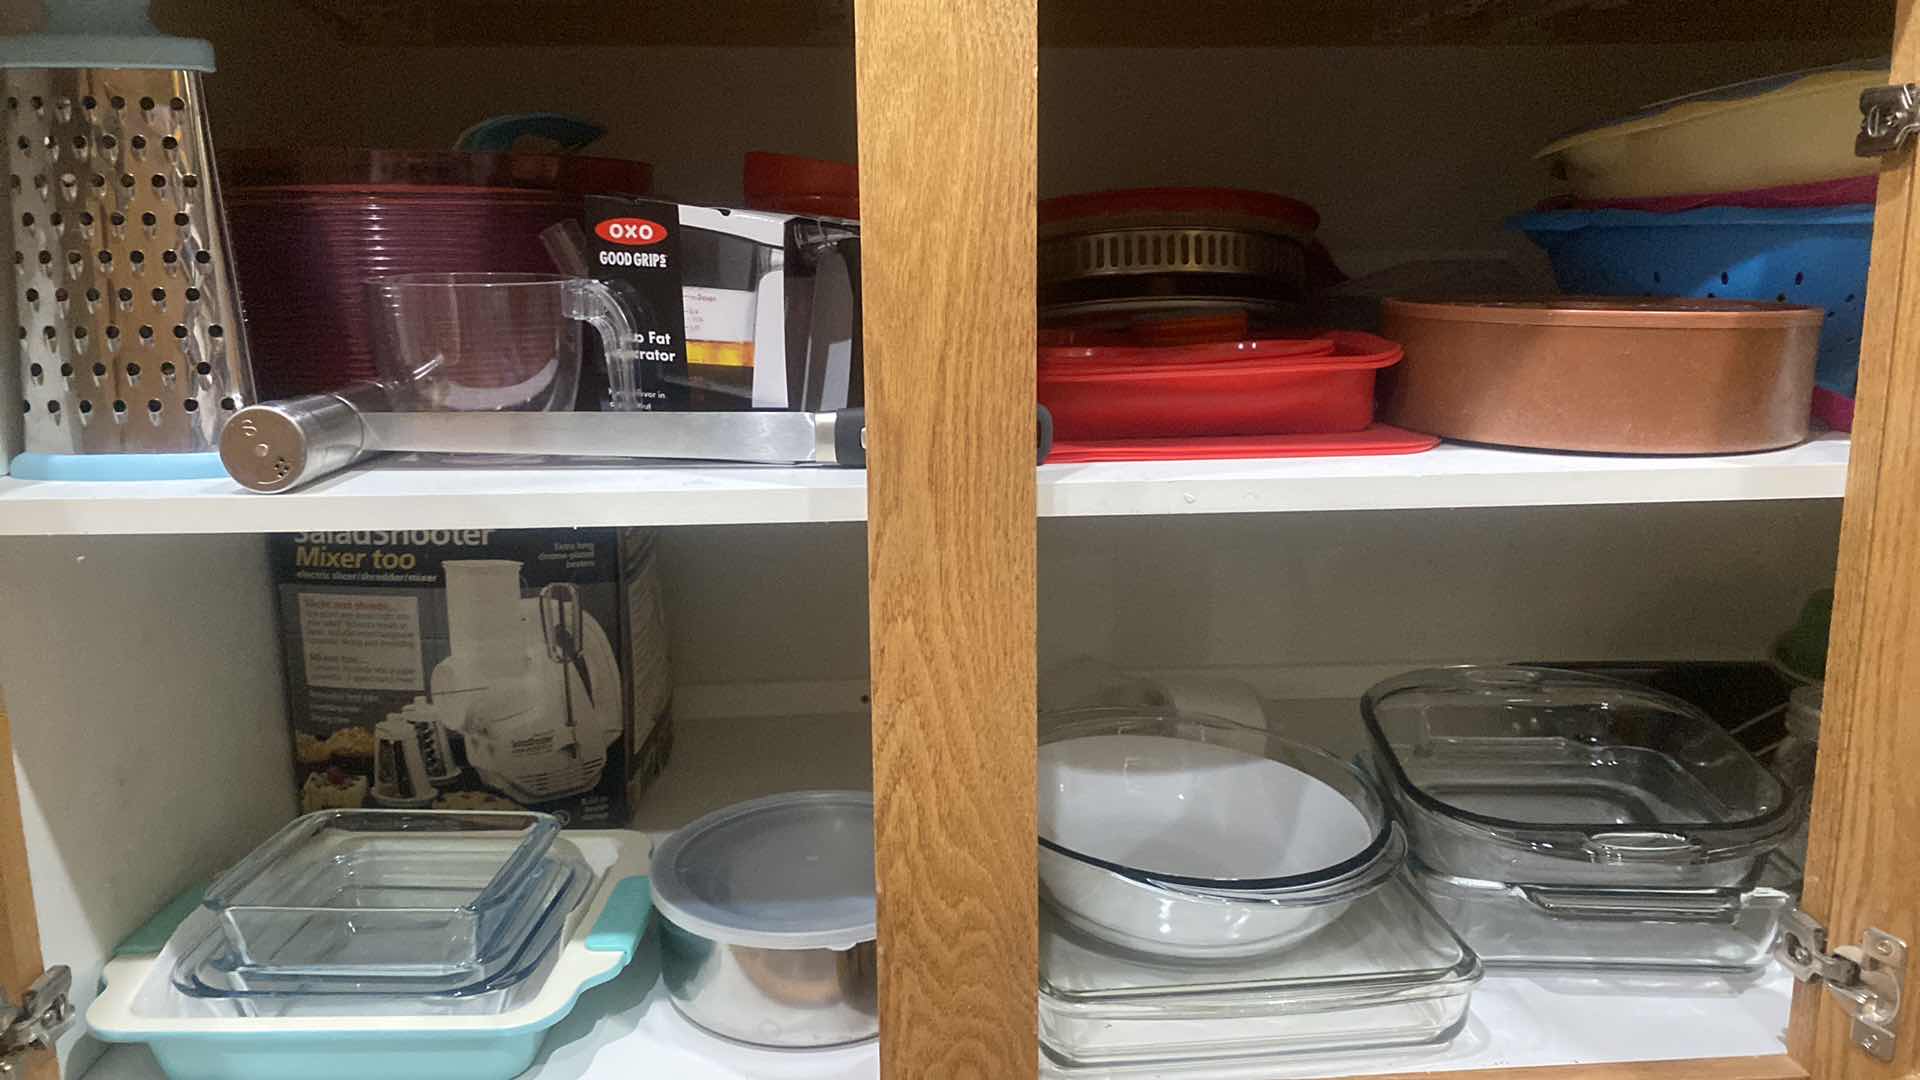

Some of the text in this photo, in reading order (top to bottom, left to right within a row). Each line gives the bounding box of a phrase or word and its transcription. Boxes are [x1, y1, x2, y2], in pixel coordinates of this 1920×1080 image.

[608, 223, 654, 240] OXO
[599, 251, 668, 268] GOOD GRIPS
[648, 331, 671, 345] Fat
[633, 348, 676, 362] rator
[296, 546, 417, 570] Mixer too
